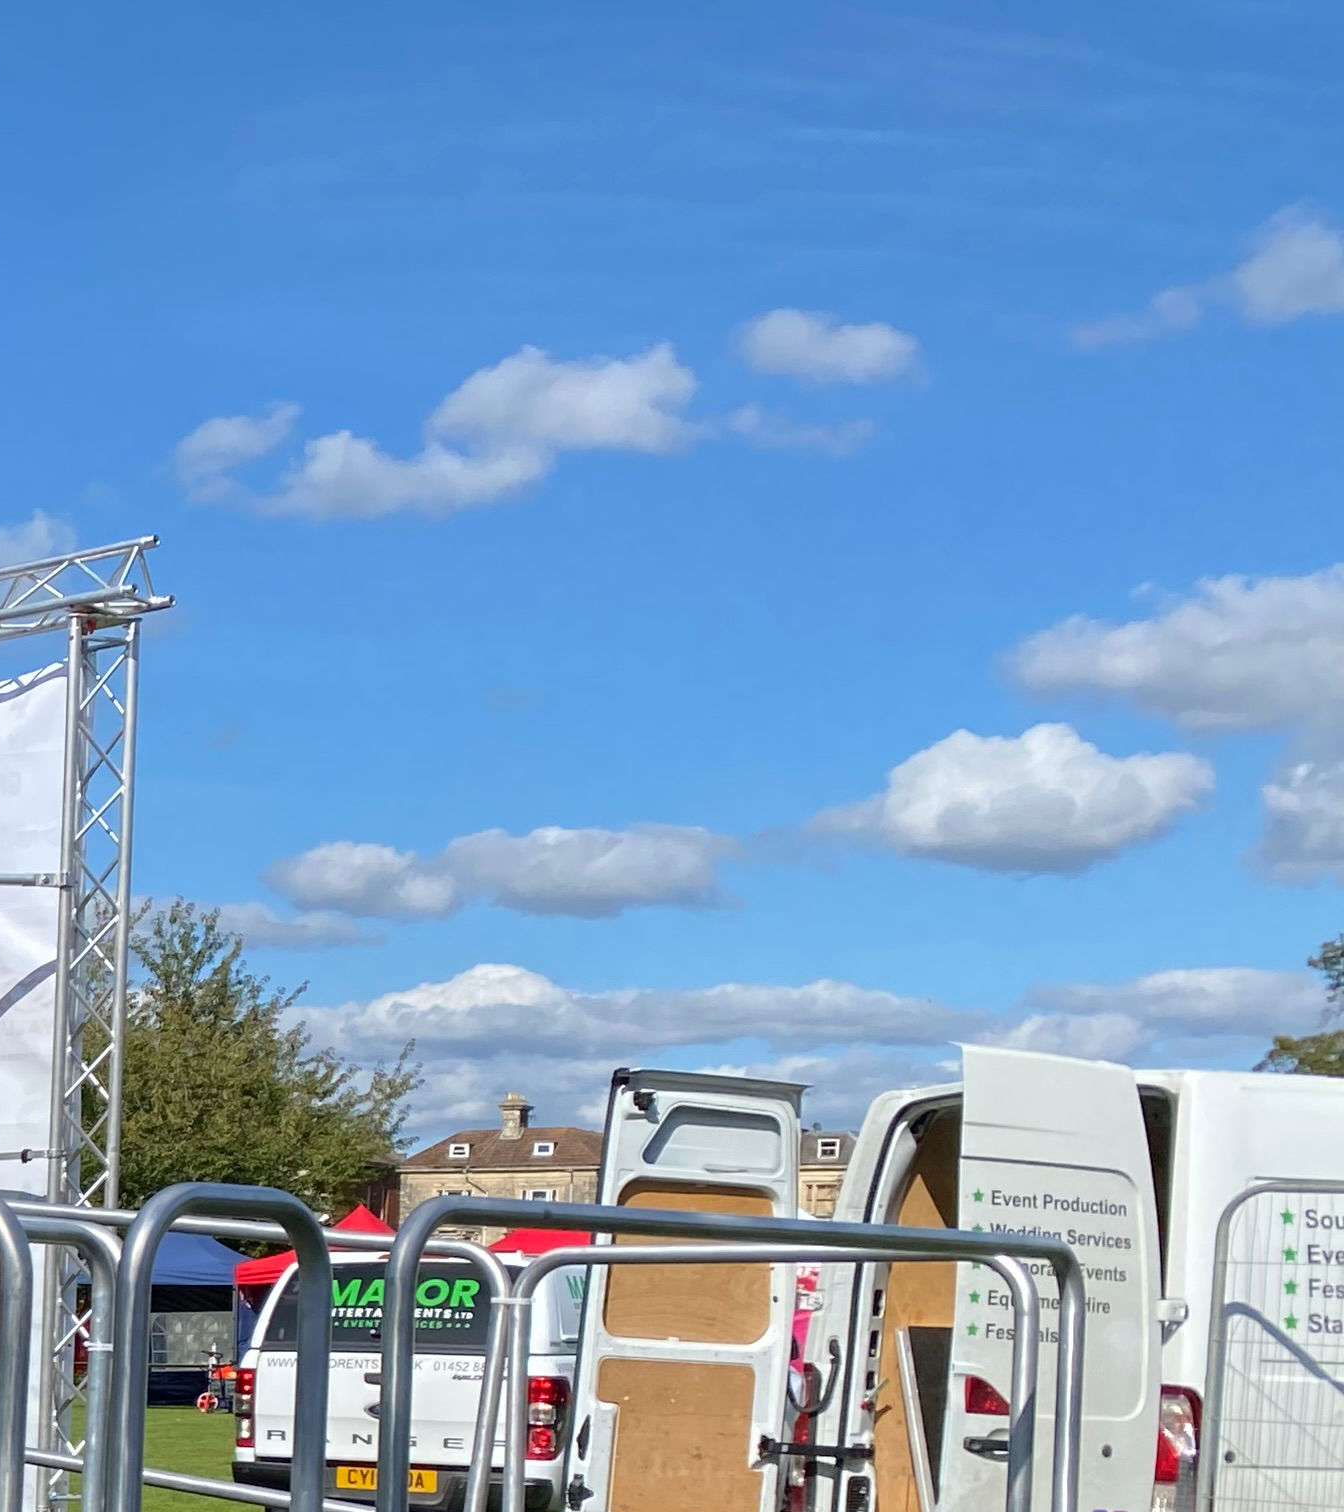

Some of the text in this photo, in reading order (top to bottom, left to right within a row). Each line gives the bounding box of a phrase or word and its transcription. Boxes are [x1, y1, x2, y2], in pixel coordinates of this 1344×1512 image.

[991, 1190, 1127, 1216] Event Production
[1067, 1229, 1131, 1250] Services
[332, 1279, 480, 1308] MAOR
[986, 1324, 1058, 1343] Fesals
[433, 1361, 470, 1371] 01452
